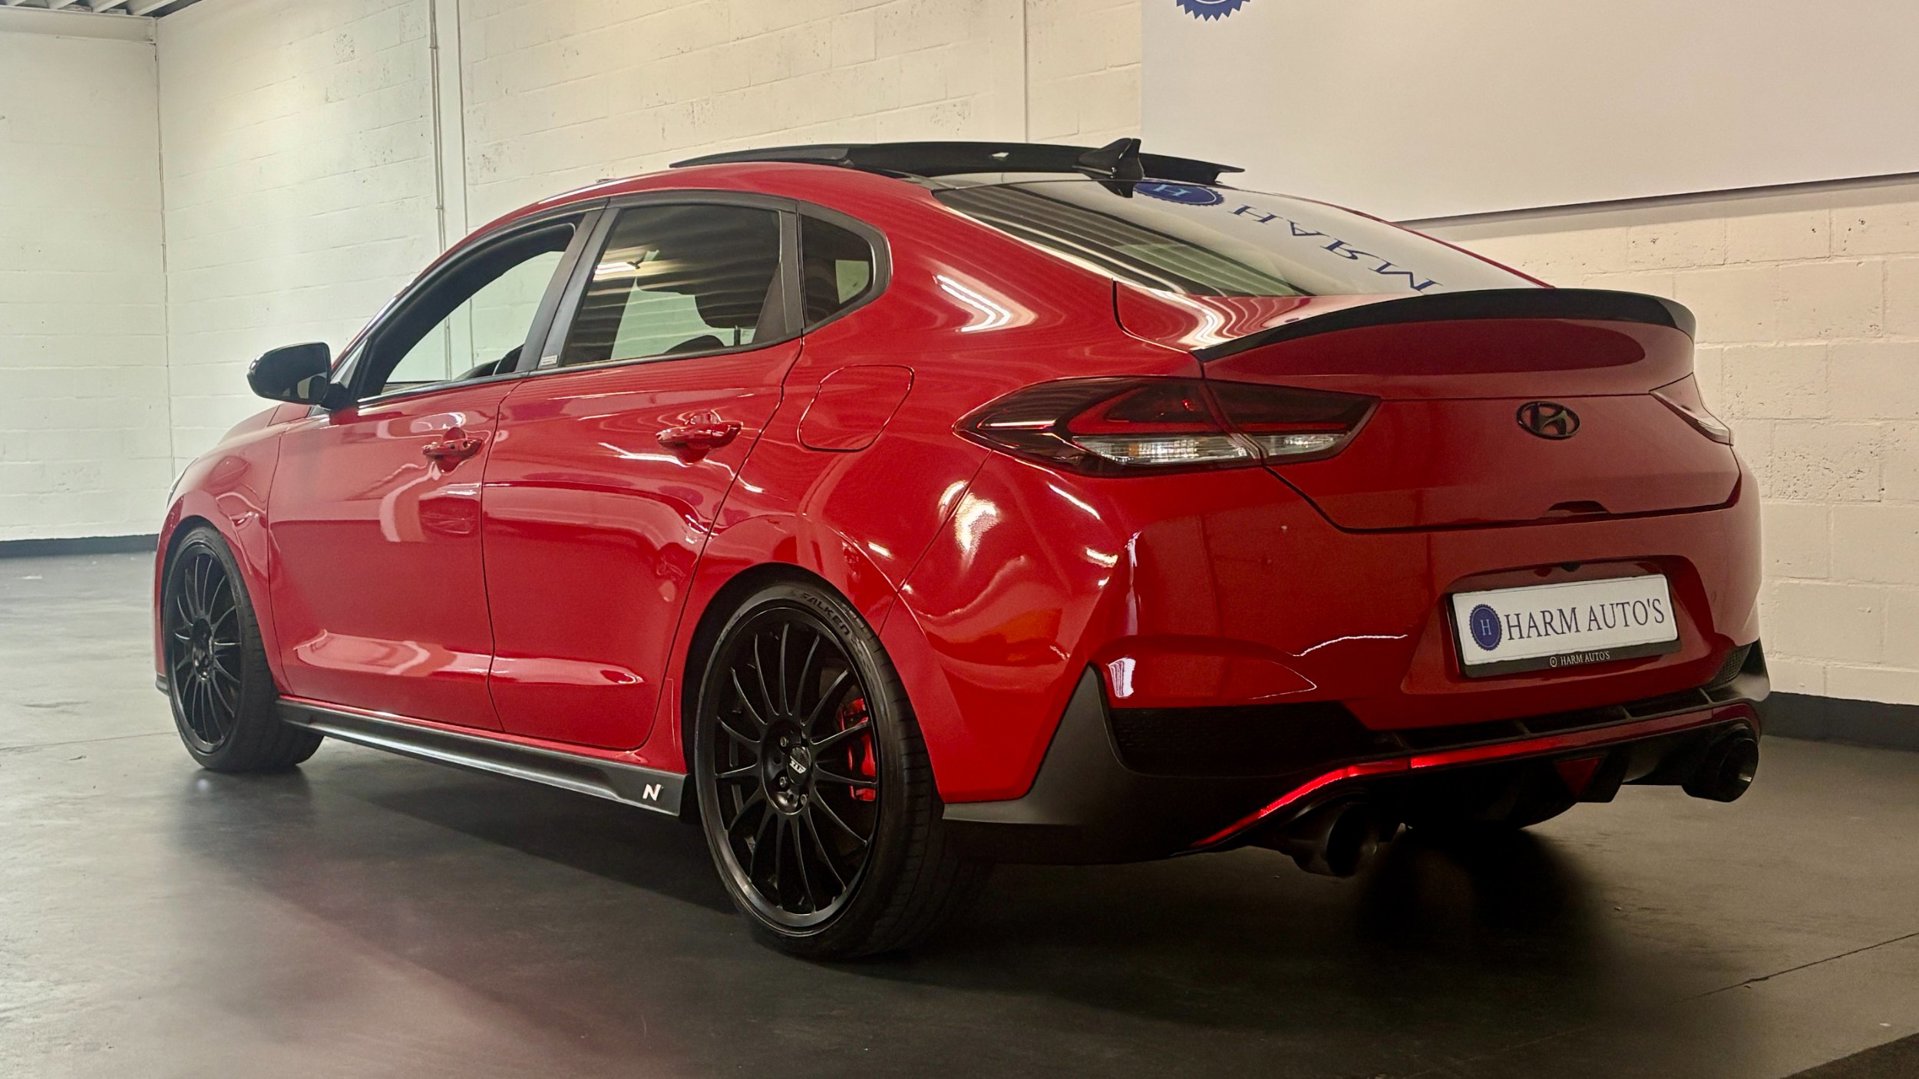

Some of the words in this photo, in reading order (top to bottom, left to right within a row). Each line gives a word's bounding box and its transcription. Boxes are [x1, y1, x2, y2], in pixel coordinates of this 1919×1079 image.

[802, 592, 850, 635] FALKEN
[1504, 607, 1580, 640] HARM
[1587, 598, 1665, 631] AUTO'S
[1480, 618, 1492, 636] H
[1560, 654, 1583, 666] HARM
[642, 783, 662, 801] N
